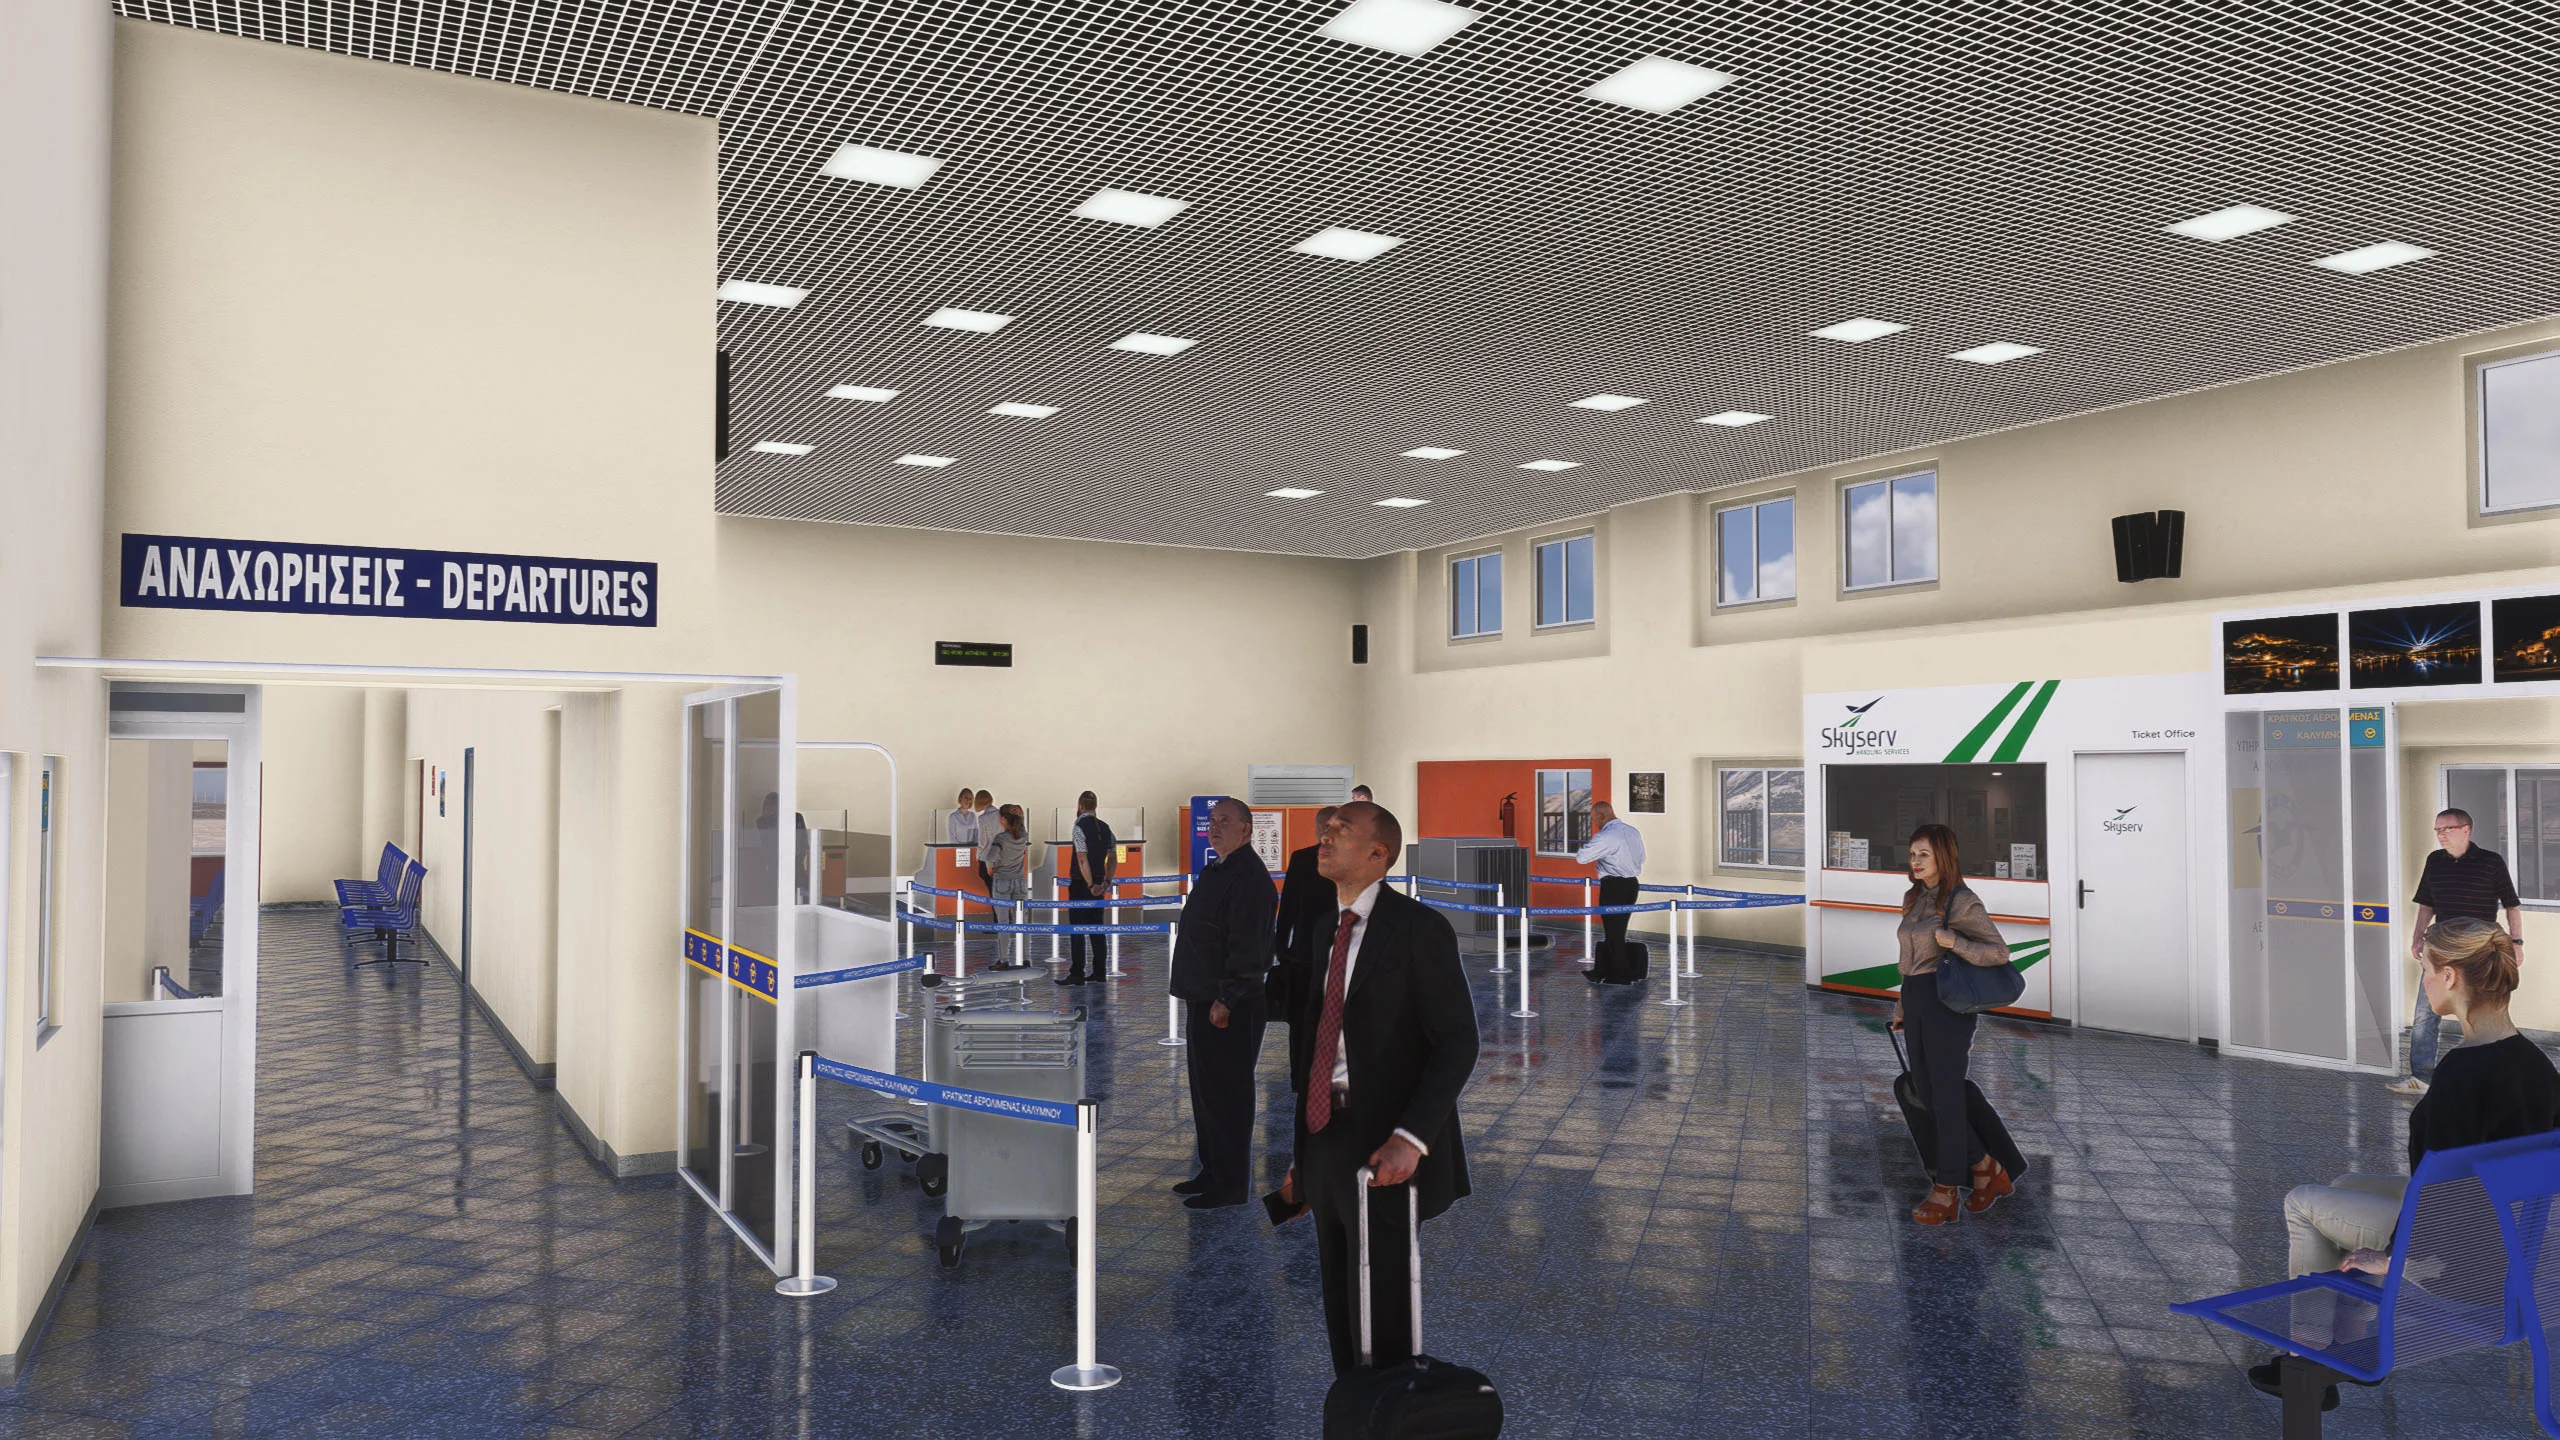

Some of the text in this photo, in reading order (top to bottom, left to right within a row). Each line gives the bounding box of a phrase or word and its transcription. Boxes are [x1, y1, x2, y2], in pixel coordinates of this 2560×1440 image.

[138, 545, 404, 607] ΑΝΑΧΩΡΗΣΕΙΣ
[443, 561, 649, 618] DEPARTURES
[1821, 727, 1897, 755] Skyserv
[2131, 729, 2196, 739] Ticket Office
[2296, 730, 2341, 740] ΚΑΛΥΜΝΟ
[2103, 820, 2144, 835] Skyserv
[942, 1089, 972, 1104] ΚΡΑΤΙΚΟΣ
[1021, 1103, 1061, 1119] ΚΑΛΥΜΝΟΥ
